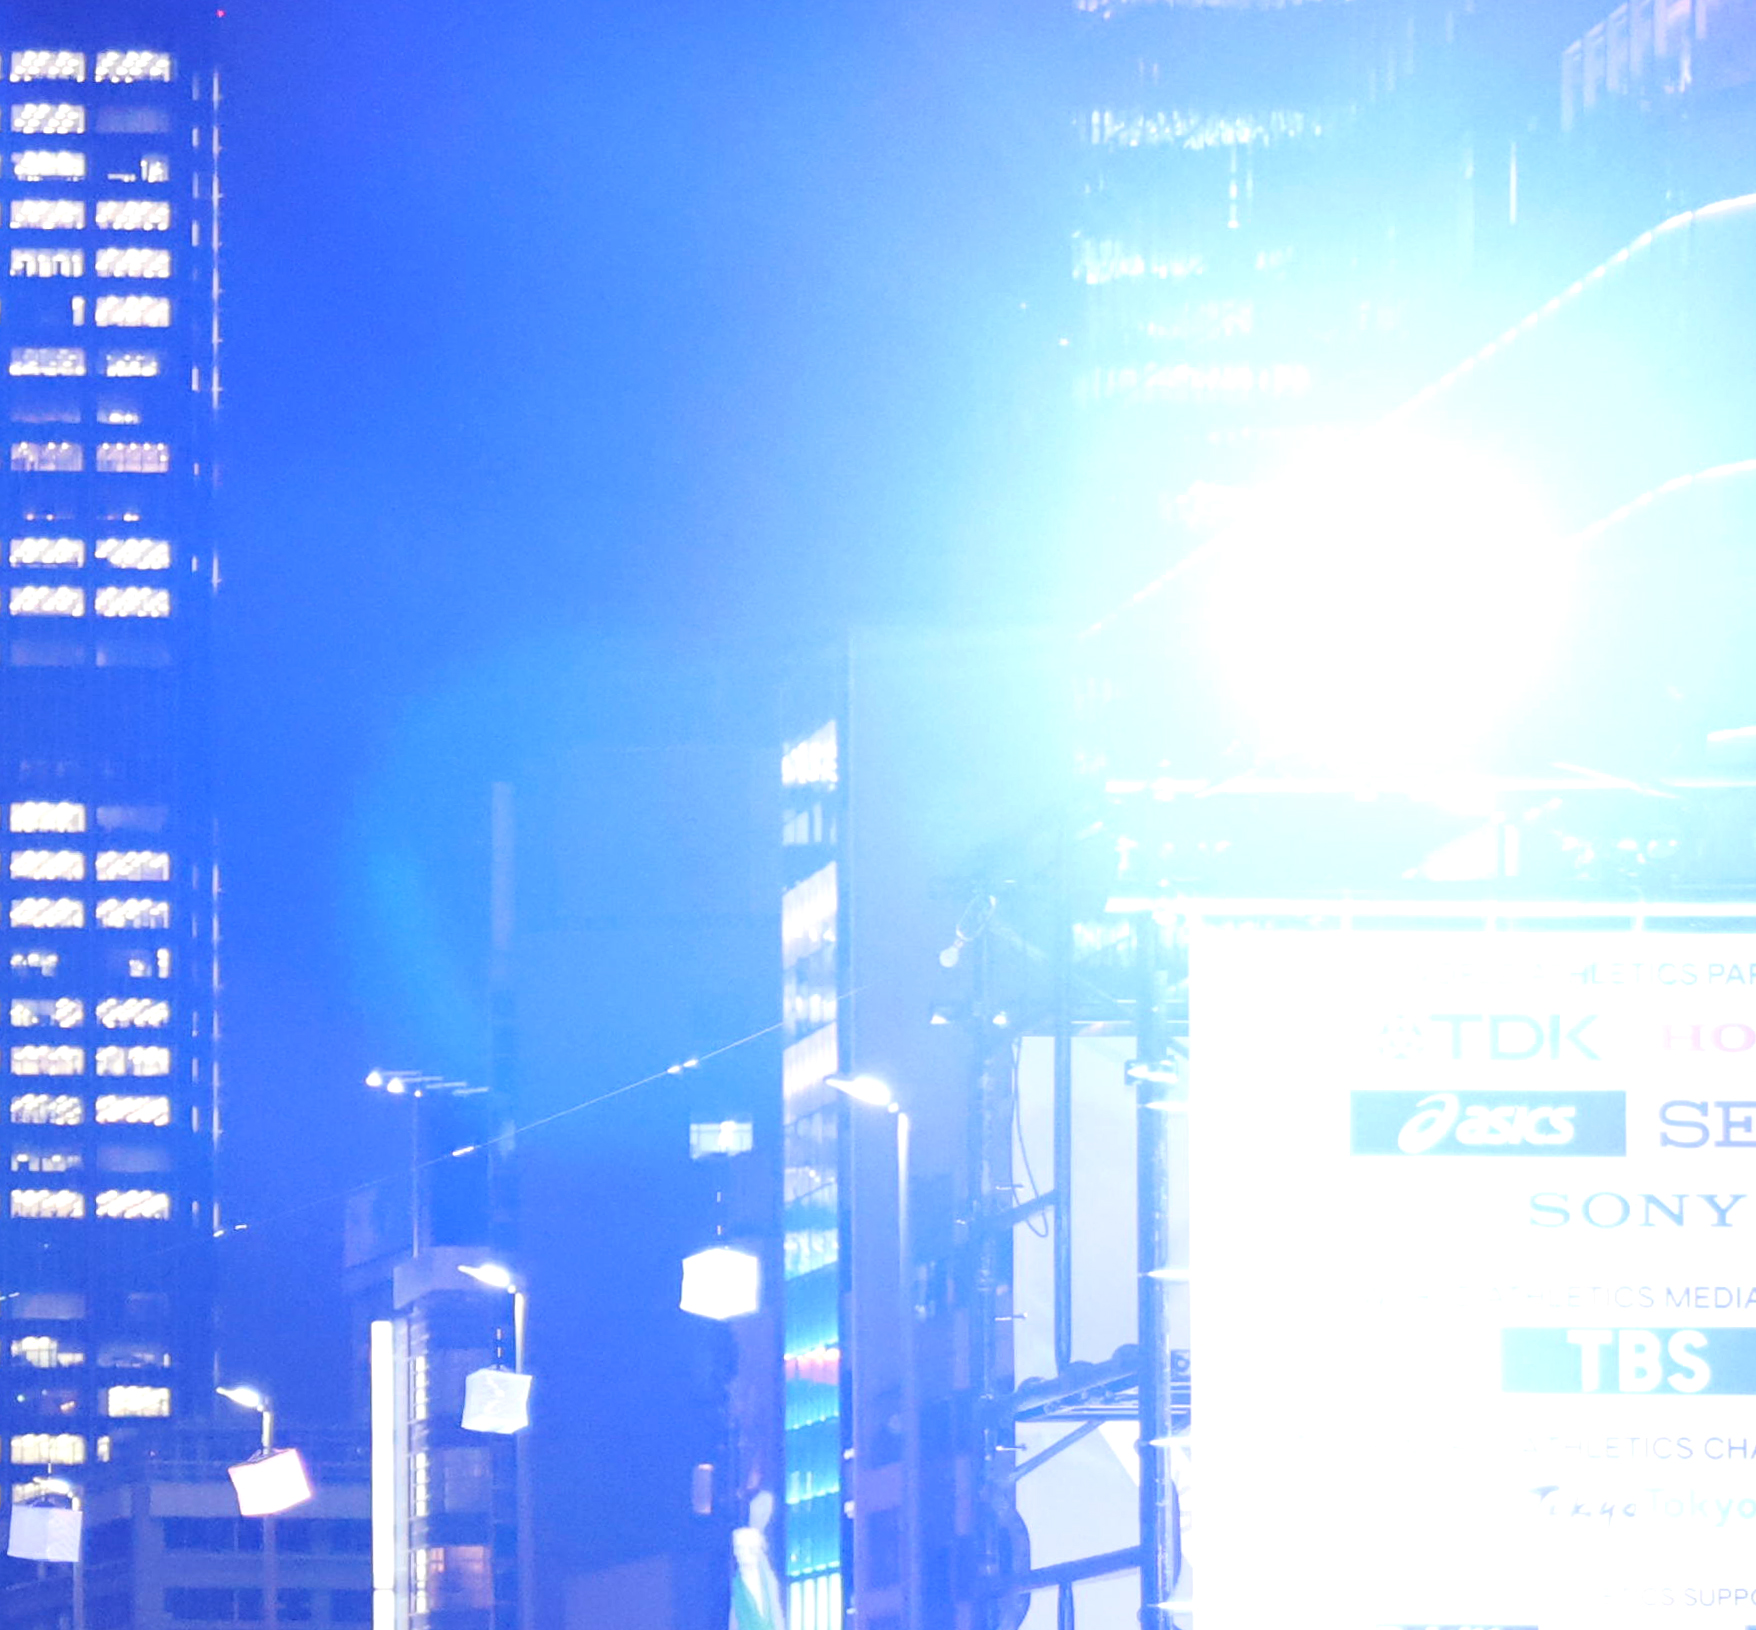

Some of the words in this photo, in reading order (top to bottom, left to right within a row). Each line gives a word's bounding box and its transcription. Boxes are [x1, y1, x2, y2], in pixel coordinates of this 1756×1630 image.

[1427, 1013, 1602, 1061] TDK
[1454, 1105, 1575, 1146] asics
[1528, 1190, 1749, 1229] SONY
[1566, 1329, 1711, 1393] TBS
